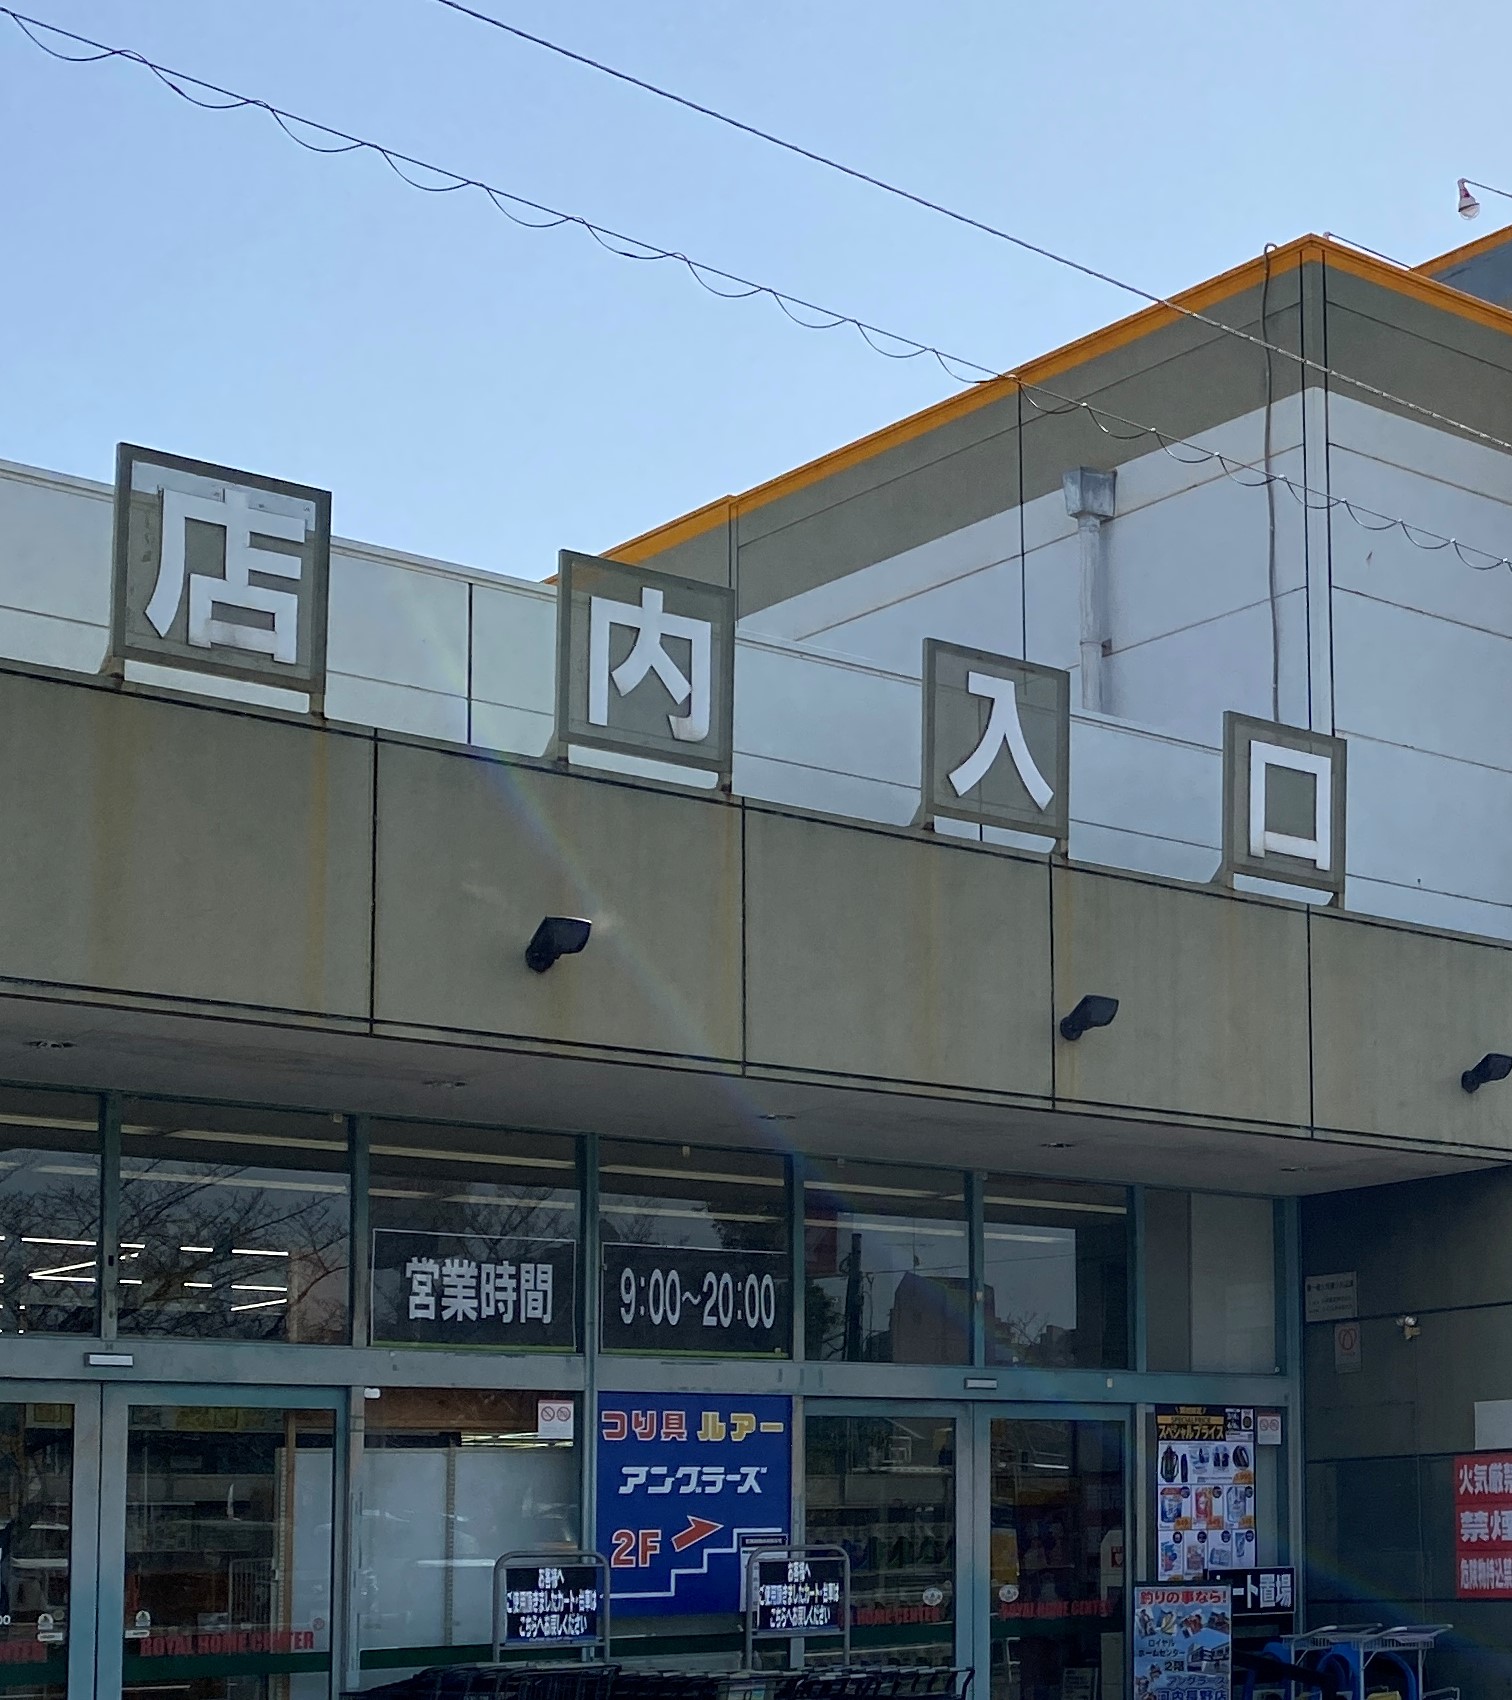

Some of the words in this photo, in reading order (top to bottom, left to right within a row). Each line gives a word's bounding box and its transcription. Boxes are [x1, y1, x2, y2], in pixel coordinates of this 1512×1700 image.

[405, 1256, 554, 1325] 営業時間
[601, 1410, 687, 1441] つり具
[697, 1411, 784, 1442] ルアー
[618, 1466, 768, 1494] アングラーズ
[611, 1529, 661, 1568] 2F
